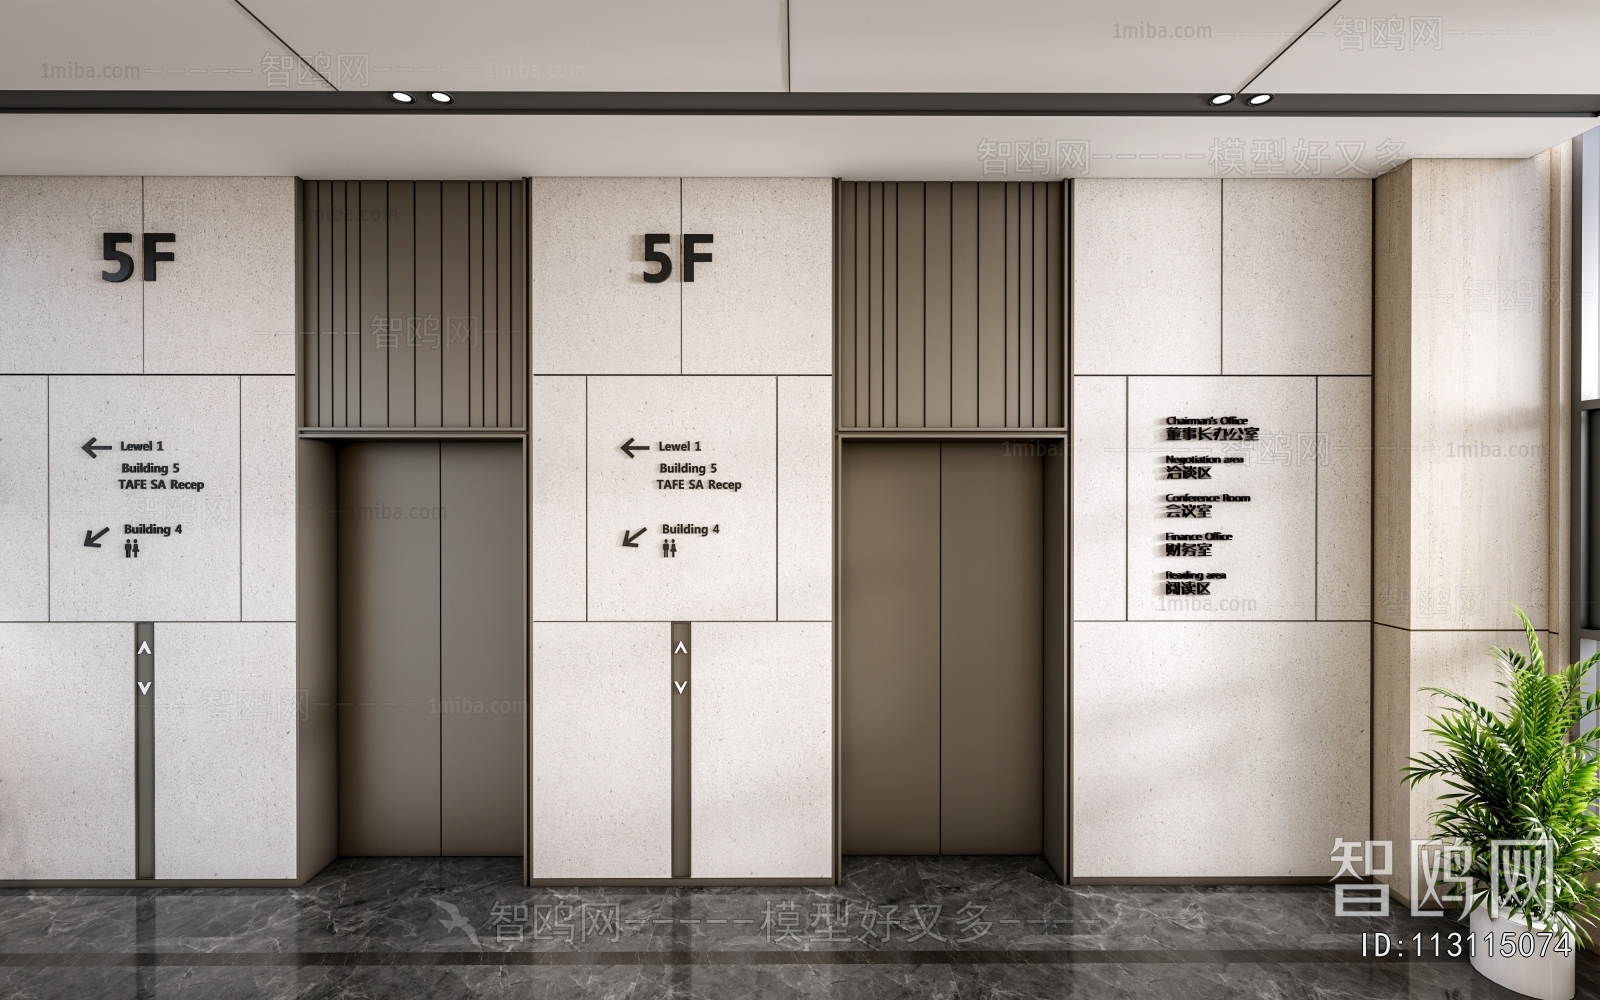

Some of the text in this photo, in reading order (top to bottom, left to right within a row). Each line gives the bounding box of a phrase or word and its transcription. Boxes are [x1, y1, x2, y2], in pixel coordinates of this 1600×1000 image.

[102, 232, 176, 283] 5F
[643, 233, 714, 283] 5F
[1165, 416, 1248, 425] Chairman's Office
[1165, 426, 1260, 441] 董事长办公室
[120, 441, 164, 451] Lewel 1
[658, 441, 702, 451] Lewel 1
[1165, 455, 1245, 466] Negotiation area
[121, 462, 180, 476] Building 5
[659, 462, 718, 476] Building 5
[1166, 465, 1212, 480] 洽谈区
[118, 479, 205, 493] TAFE SA Recep
[656, 479, 742, 493] TAFE SA Recep
[1165, 493, 1251, 502] Conference Room
[1165, 503, 1213, 519] 会议室
[124, 523, 183, 537] Building 4
[662, 523, 720, 537] Building 4
[1165, 532, 1233, 541] Finance Office
[1165, 542, 1213, 557] 财务室
[1165, 570, 1227, 581] Reading area
[1165, 580, 1212, 596] 阅读区
